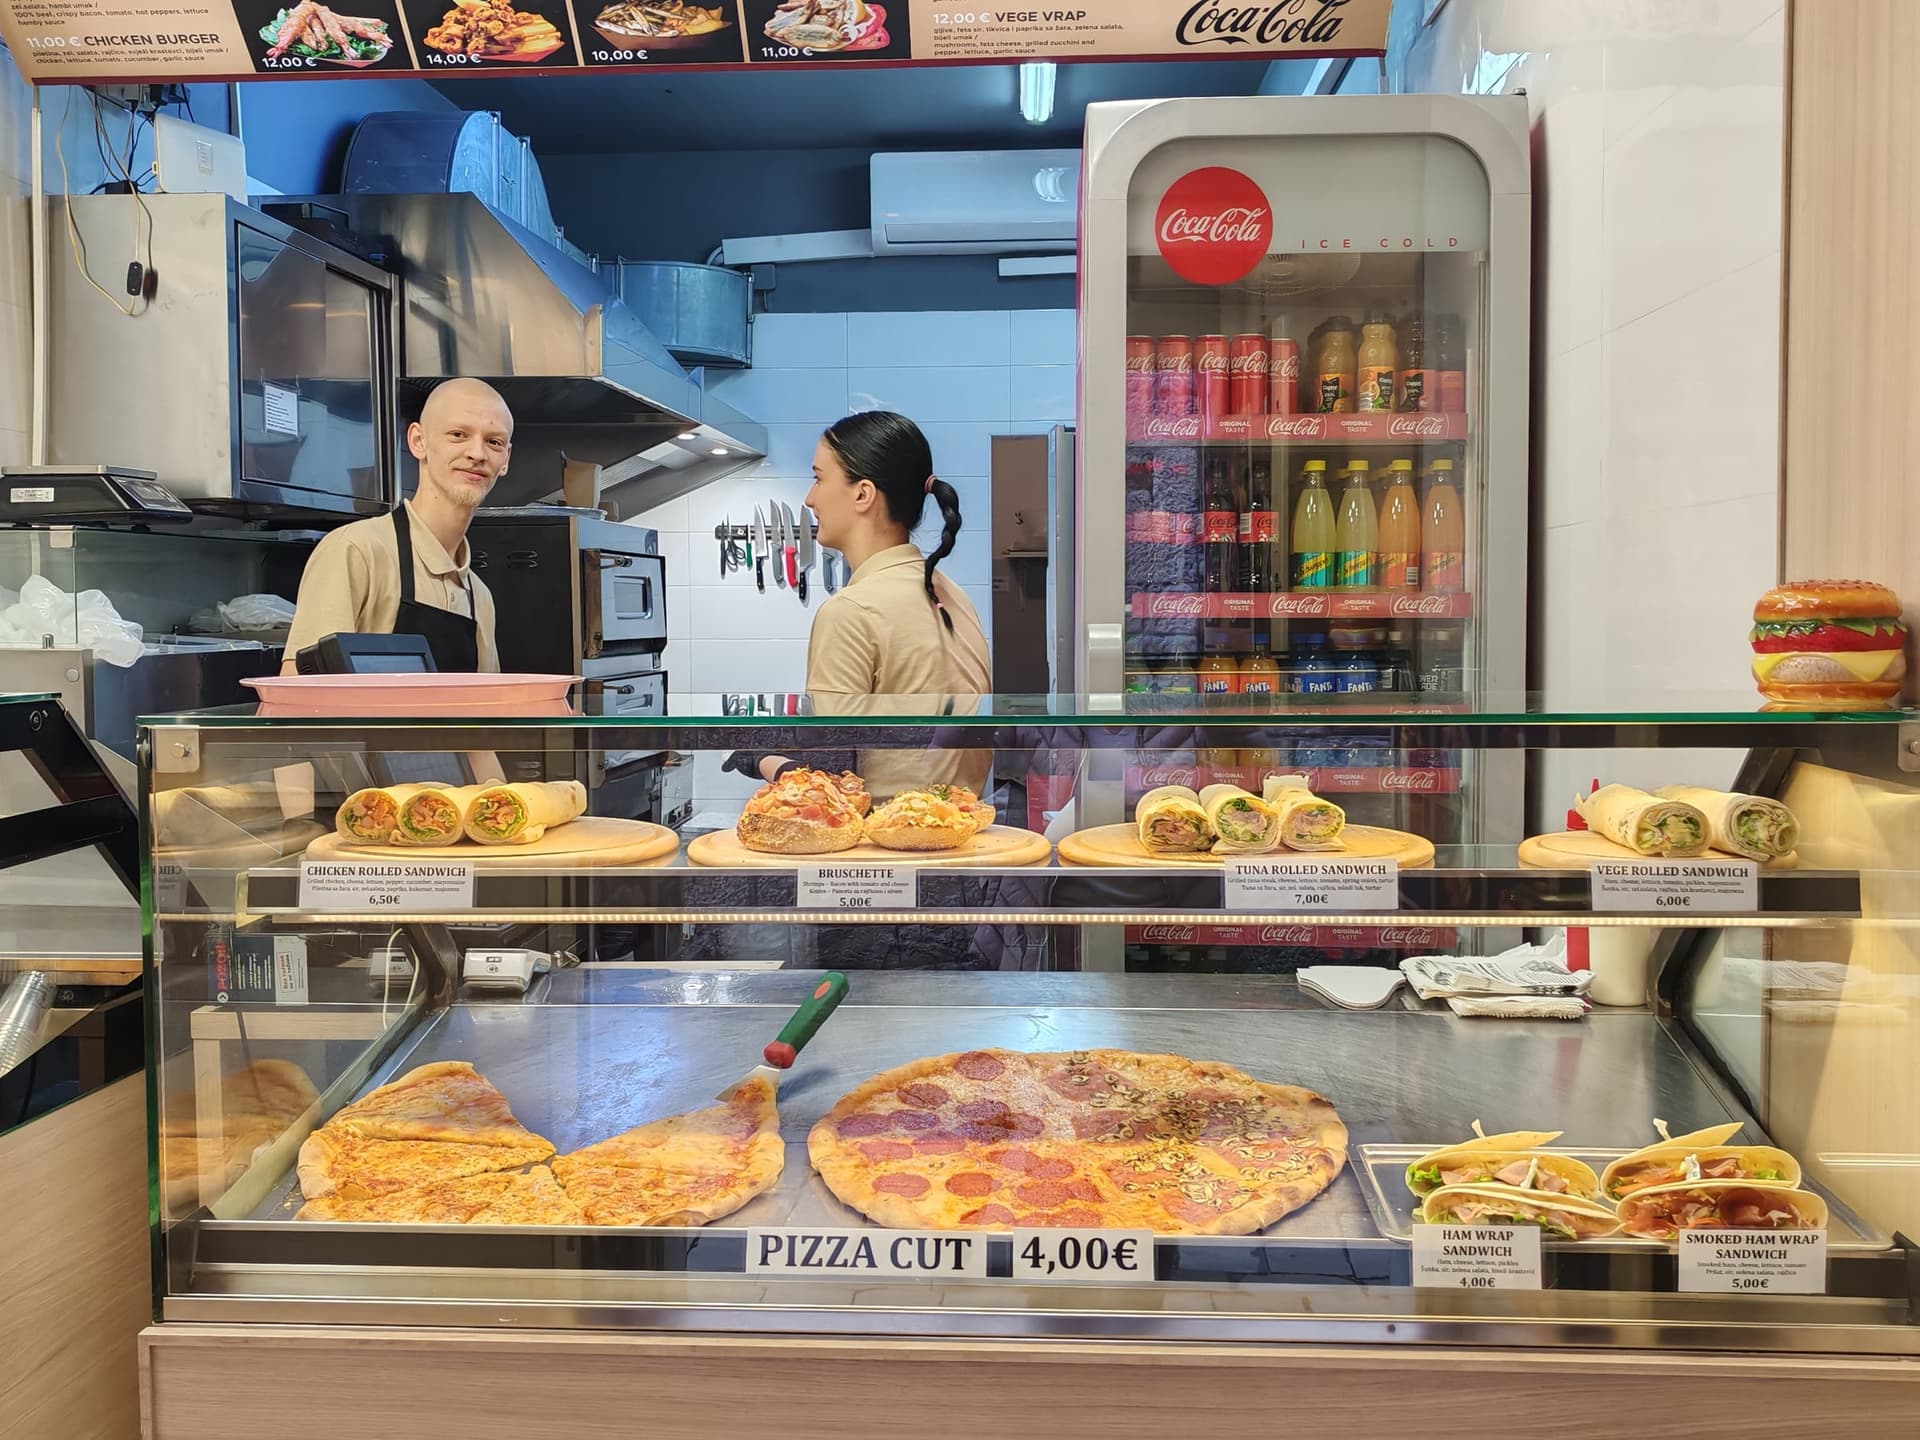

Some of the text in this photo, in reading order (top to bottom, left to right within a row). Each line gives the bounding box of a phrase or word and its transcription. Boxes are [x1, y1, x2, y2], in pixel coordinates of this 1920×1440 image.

[933, 10, 1087, 25] 12,00 € VEGE VRAP
[1176, 0, 1350, 45] Coca-Cola
[26, 33, 221, 49] 11,00 € CHICKEN BURGER
[592, 50, 648, 62] 10,00 €
[761, 47, 814, 58] 11,00 €
[262, 57, 317, 68] 12,00 €
[426, 54, 482, 65] 14,00 €
[1161, 208, 1266, 243] Coca-Cola
[1302, 237, 1458, 249] ICE COLD
[1148, 418, 1200, 436] Coca-Cola
[1268, 418, 1322, 436] Coca-Cola
[1391, 417, 1445, 435] Coca-Cola
[1152, 596, 1205, 614] Coca-Cola
[1272, 596, 1326, 614] Coca-Cola
[1393, 596, 1448, 614] Coca-Cola
[1143, 769, 1196, 787] Coca-Cola
[1383, 771, 1436, 789] Coca-Cola
[307, 866, 466, 877] CHICKEN ROLLED SANDWICH
[818, 868, 894, 879] BRUSCHETTE
[1235, 865, 1386, 875] TUNA ROLLED SANDWICH
[1597, 865, 1749, 877] VEGE ROLLED SANDWICH
[369, 895, 401, 906] 6,50€
[840, 897, 872, 907] 5,00€
[1295, 894, 1329, 905] 7,00€
[1656, 896, 1691, 907] 6,00€
[1143, 924, 1193, 941] Coca-Cola
[1261, 925, 1313, 943] Coca-Cola
[1381, 926, 1433, 944] Coca-Cola
[1442, 1229, 1514, 1241] HAM WRAP
[1686, 1233, 1819, 1245] SMOKED HAM WRAP
[759, 1234, 972, 1270] PIZZA CUT
[1021, 1236, 1139, 1275] 4,00€
[1443, 1245, 1512, 1256] SANDWICH
[1715, 1249, 1788, 1260] SANDWICH
[1459, 1277, 1496, 1288] 4,00€
[1732, 1278, 1769, 1289] 5,00€
